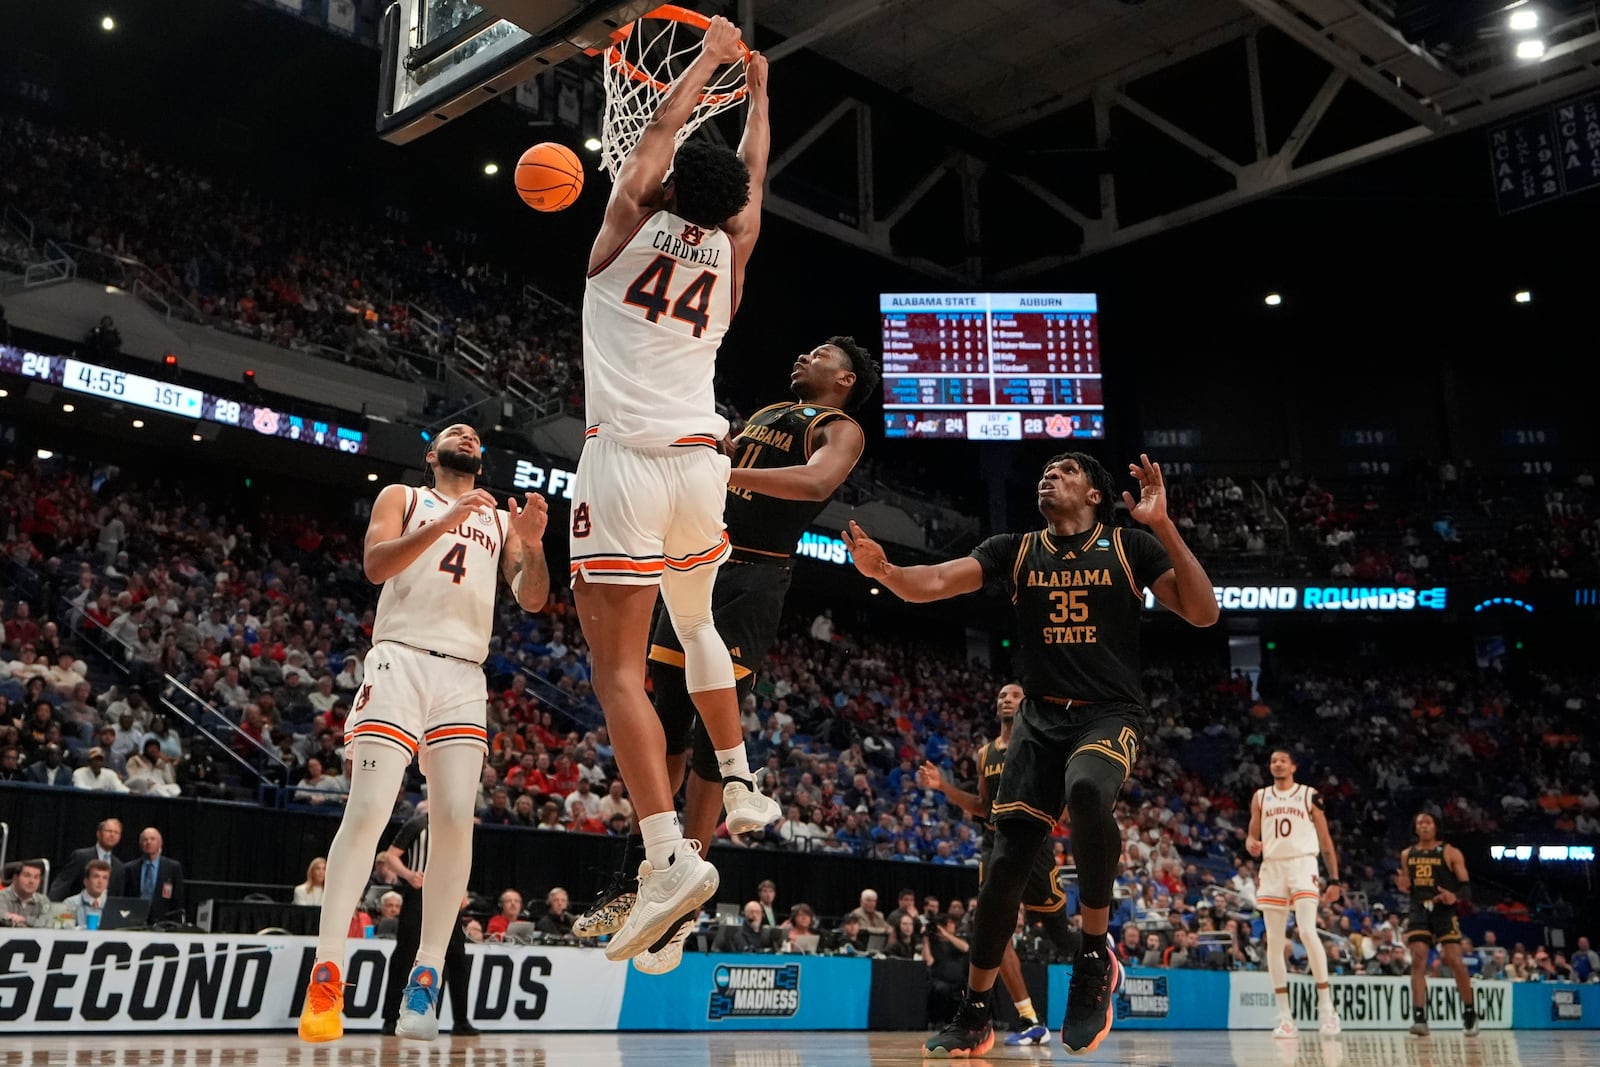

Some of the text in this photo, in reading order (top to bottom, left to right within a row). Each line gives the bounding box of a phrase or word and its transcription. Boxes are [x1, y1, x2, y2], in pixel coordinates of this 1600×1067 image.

[652, 230, 720, 268] CARDWELL
[622, 252, 719, 339] 44
[892, 297, 977, 306] ALABAMA STATE
[1019, 297, 1062, 307] AUBURN
[22, 352, 50, 379] 24
[78, 366, 182, 407] 4:55 1ST
[214, 400, 240, 423] 28
[945, 418, 963, 433] 24
[980, 424, 1009, 436] 4:55
[1024, 418, 1042, 432] 28
[315, 432, 324, 445] 4
[739, 443, 763, 470] 11
[795, 531, 847, 565] NDS
[438, 542, 468, 585] 4
[1026, 568, 1113, 588] ALABAMA
[1048, 590, 1089, 624] 35
[1212, 586, 1416, 610] ECOND ROUNDS
[1042, 625, 1097, 645] STATE
[1265, 806, 1305, 820] AUBURN
[1275, 818, 1292, 839] 10
[1415, 865, 1432, 878] 20
[0, 939, 552, 1021] SECOND ODS
[729, 968, 776, 989] MARCH
[1125, 979, 1154, 995] MARCH
[734, 989, 798, 1010] MADNESS
[1130, 996, 1168, 1012] MADNESS
[1240, 993, 1268, 1007] HOSTED
[1287, 981, 1393, 1022] UNIERSITY
